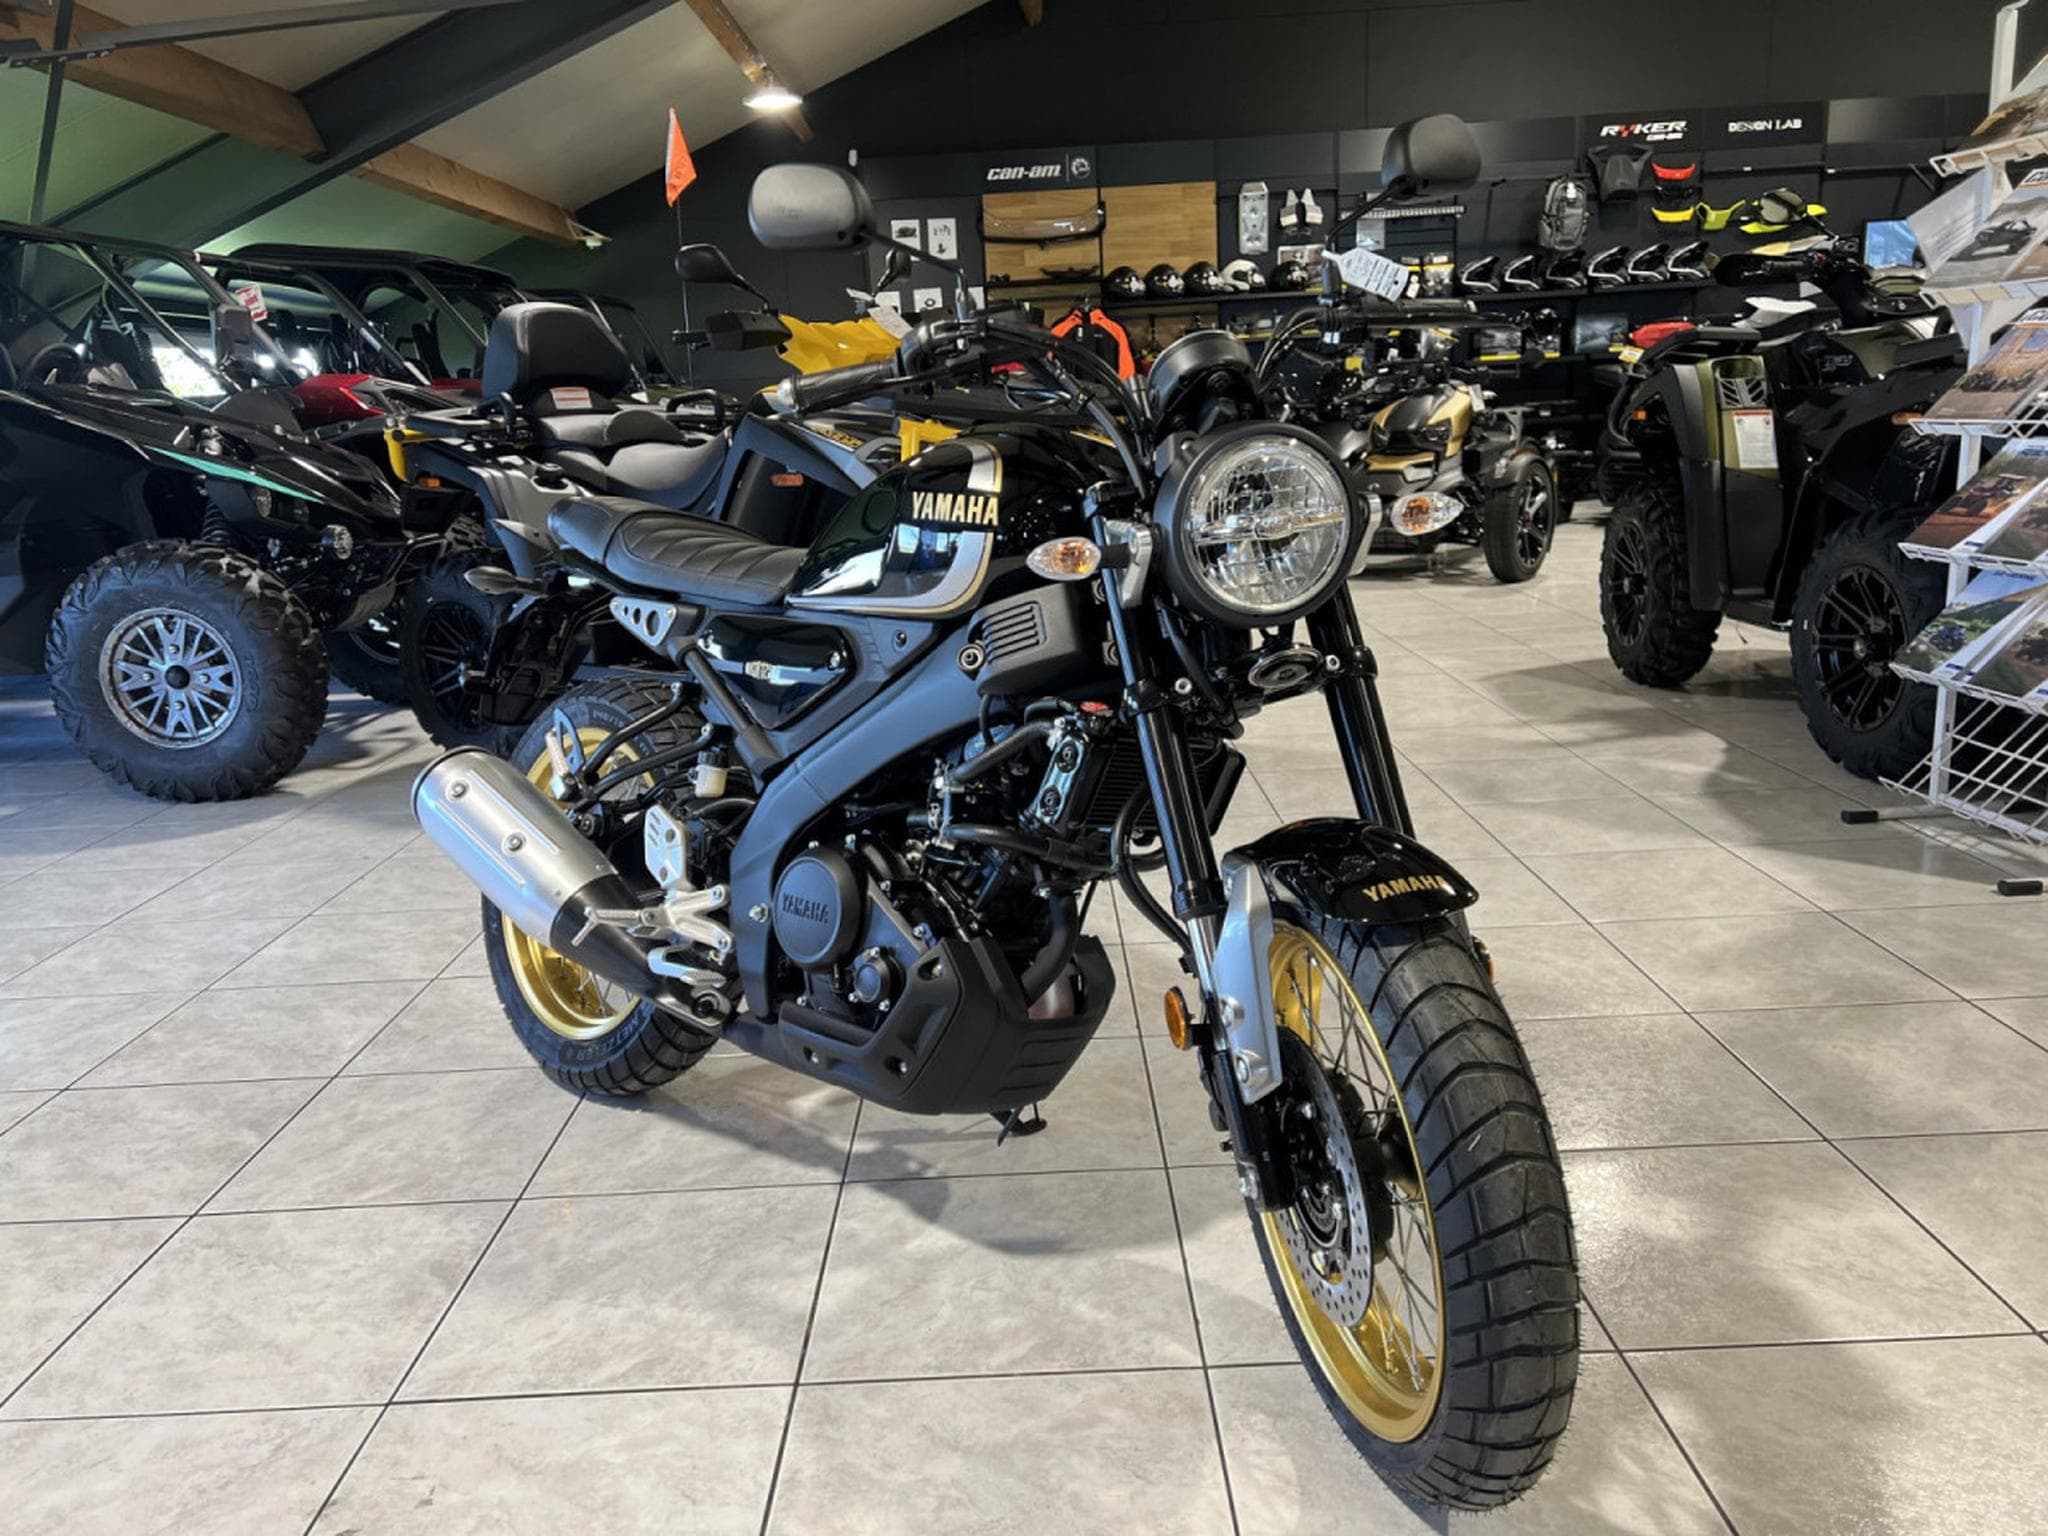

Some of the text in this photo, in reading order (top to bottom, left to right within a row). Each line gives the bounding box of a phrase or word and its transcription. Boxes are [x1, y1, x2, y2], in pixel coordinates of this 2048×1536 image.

[1600, 121, 1687, 138] RYKER
[1776, 119, 1802, 129] LAB
[912, 491, 999, 526] YAMAHA
[1362, 875, 1456, 902] YAMAHA
[783, 893, 829, 924] YAMAHA
